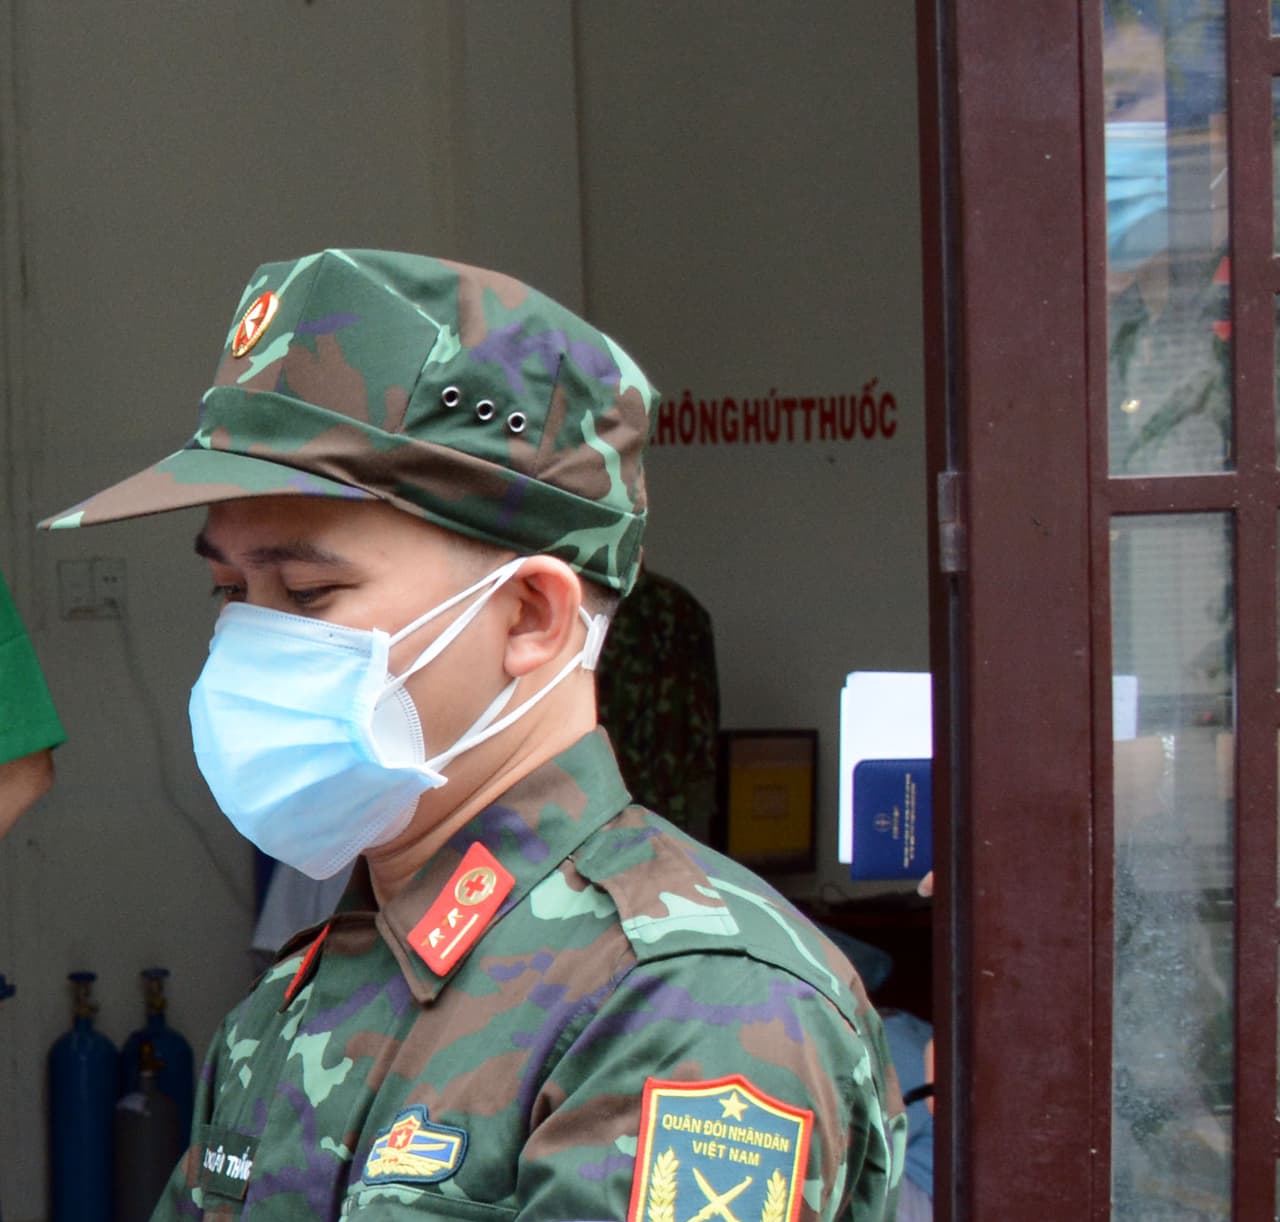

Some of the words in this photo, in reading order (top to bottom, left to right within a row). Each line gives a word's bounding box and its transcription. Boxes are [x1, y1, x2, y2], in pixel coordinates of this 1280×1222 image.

[662, 1113, 702, 1134] QUÂN
[692, 1140, 727, 1160] VIỆT
[729, 1149, 761, 1167] NAM
